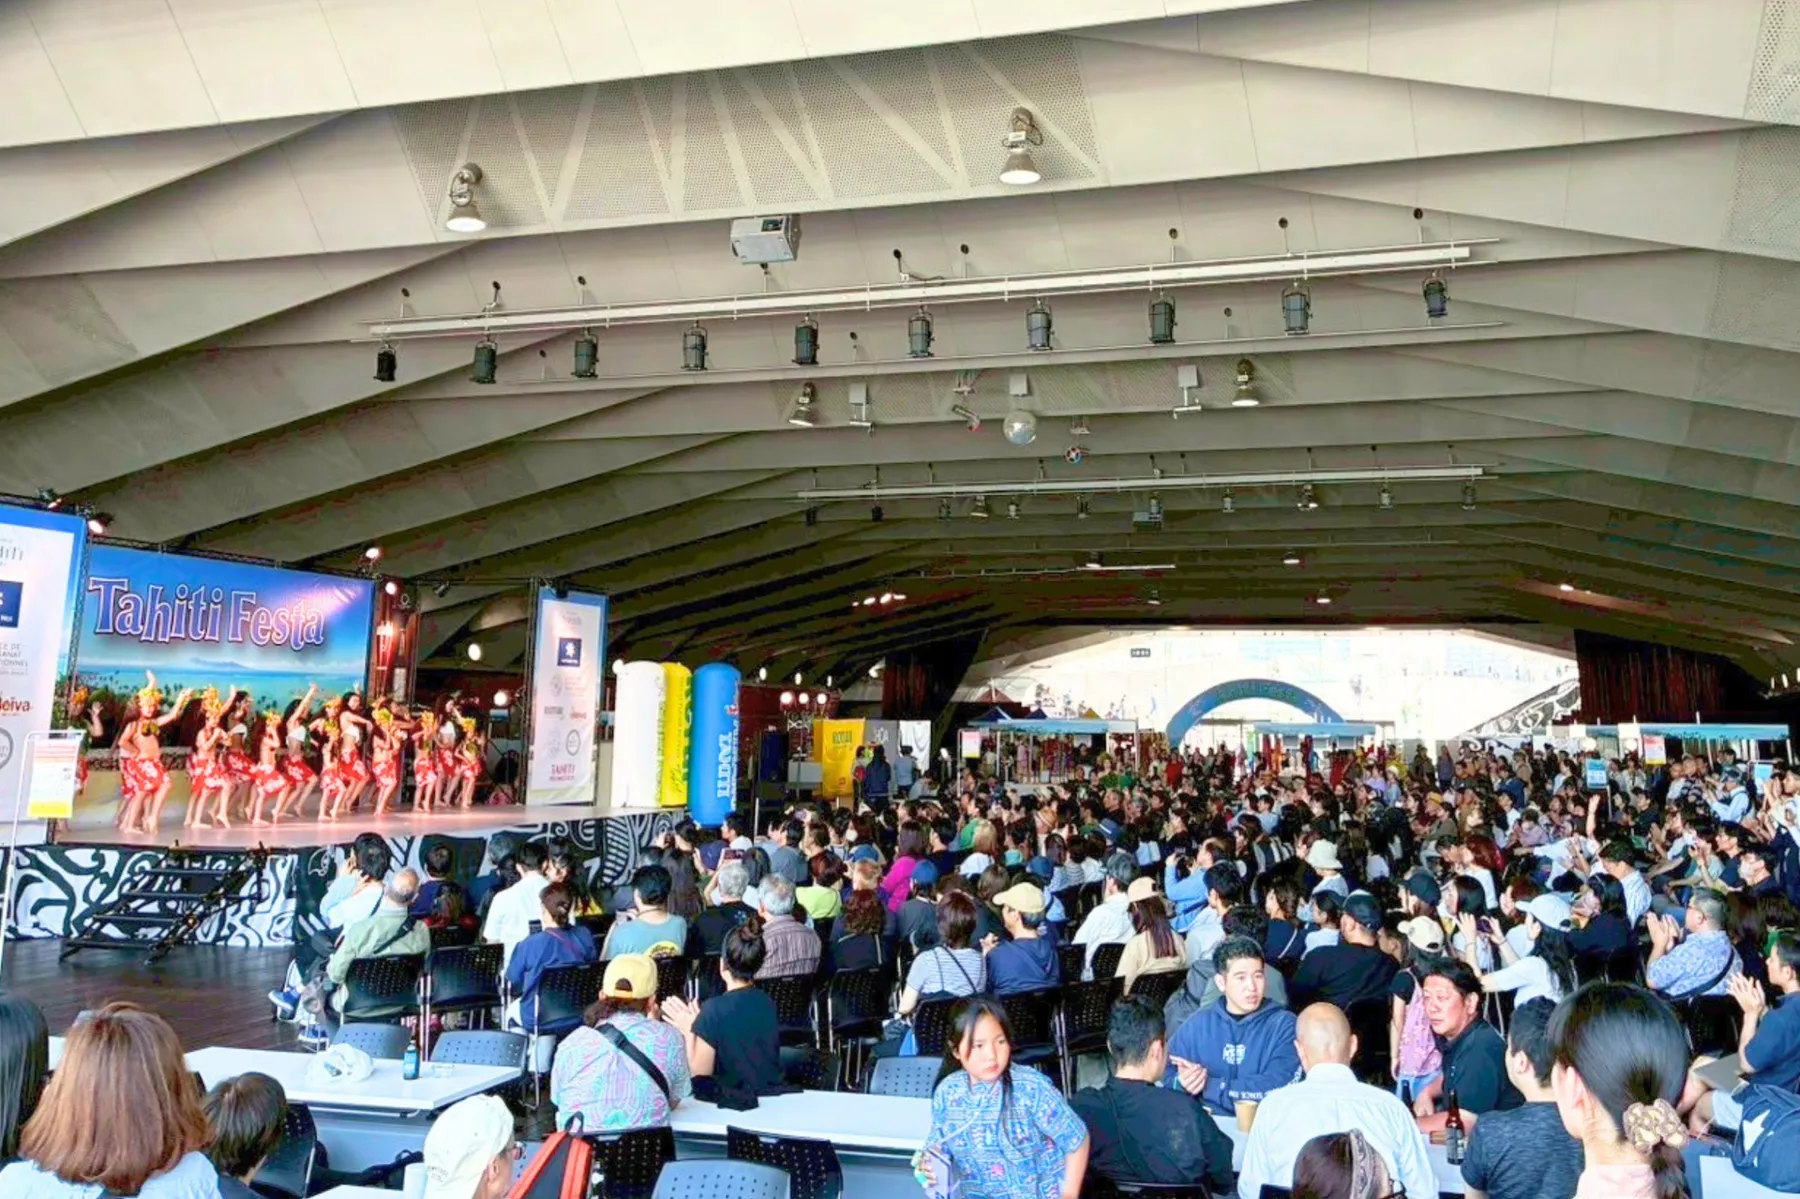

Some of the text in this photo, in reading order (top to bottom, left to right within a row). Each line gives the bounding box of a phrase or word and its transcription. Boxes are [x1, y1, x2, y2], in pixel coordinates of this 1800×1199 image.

[88, 577, 325, 650] Tahiti Festa
[0, 696, 30, 712] eiva
